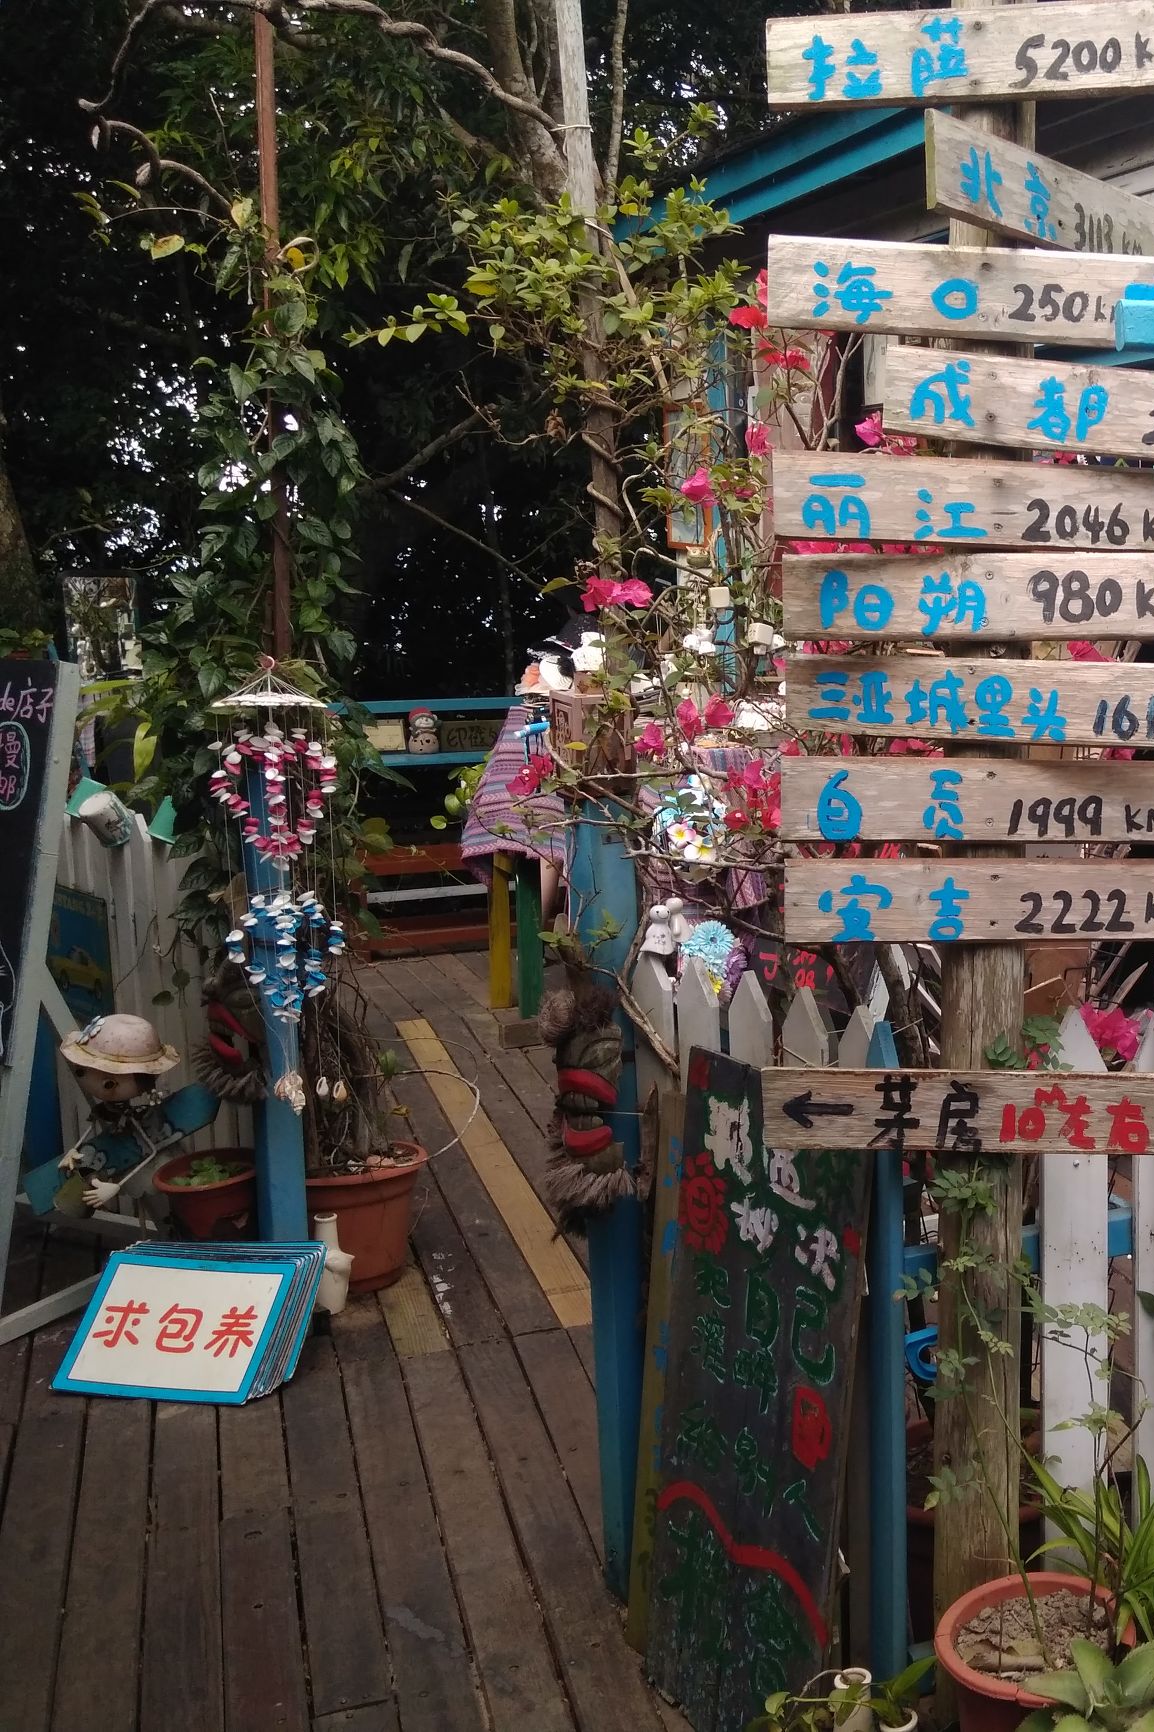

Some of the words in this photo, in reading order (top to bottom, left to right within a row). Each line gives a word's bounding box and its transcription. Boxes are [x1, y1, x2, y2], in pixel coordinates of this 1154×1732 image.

[802, 17, 968, 101] 拉萨
[1014, 33, 1122, 89] 5200
[960, 145, 1058, 241] 北京
[811, 261, 980, 325] 海口
[910, 360, 1108, 443] 成都
[802, 473, 988, 539] 丽江
[1021, 498, 1130, 545] 2046
[819, 568, 987, 636] 阳朔
[1026, 569, 1123, 624] 980
[808, 670, 1067, 742] 三亚城里头
[1007, 795, 1103, 838] 1999
[817, 874, 970, 942] 安吉
[1014, 889, 1135, 934] 2222
[92, 1299, 258, 1358] 求包养
